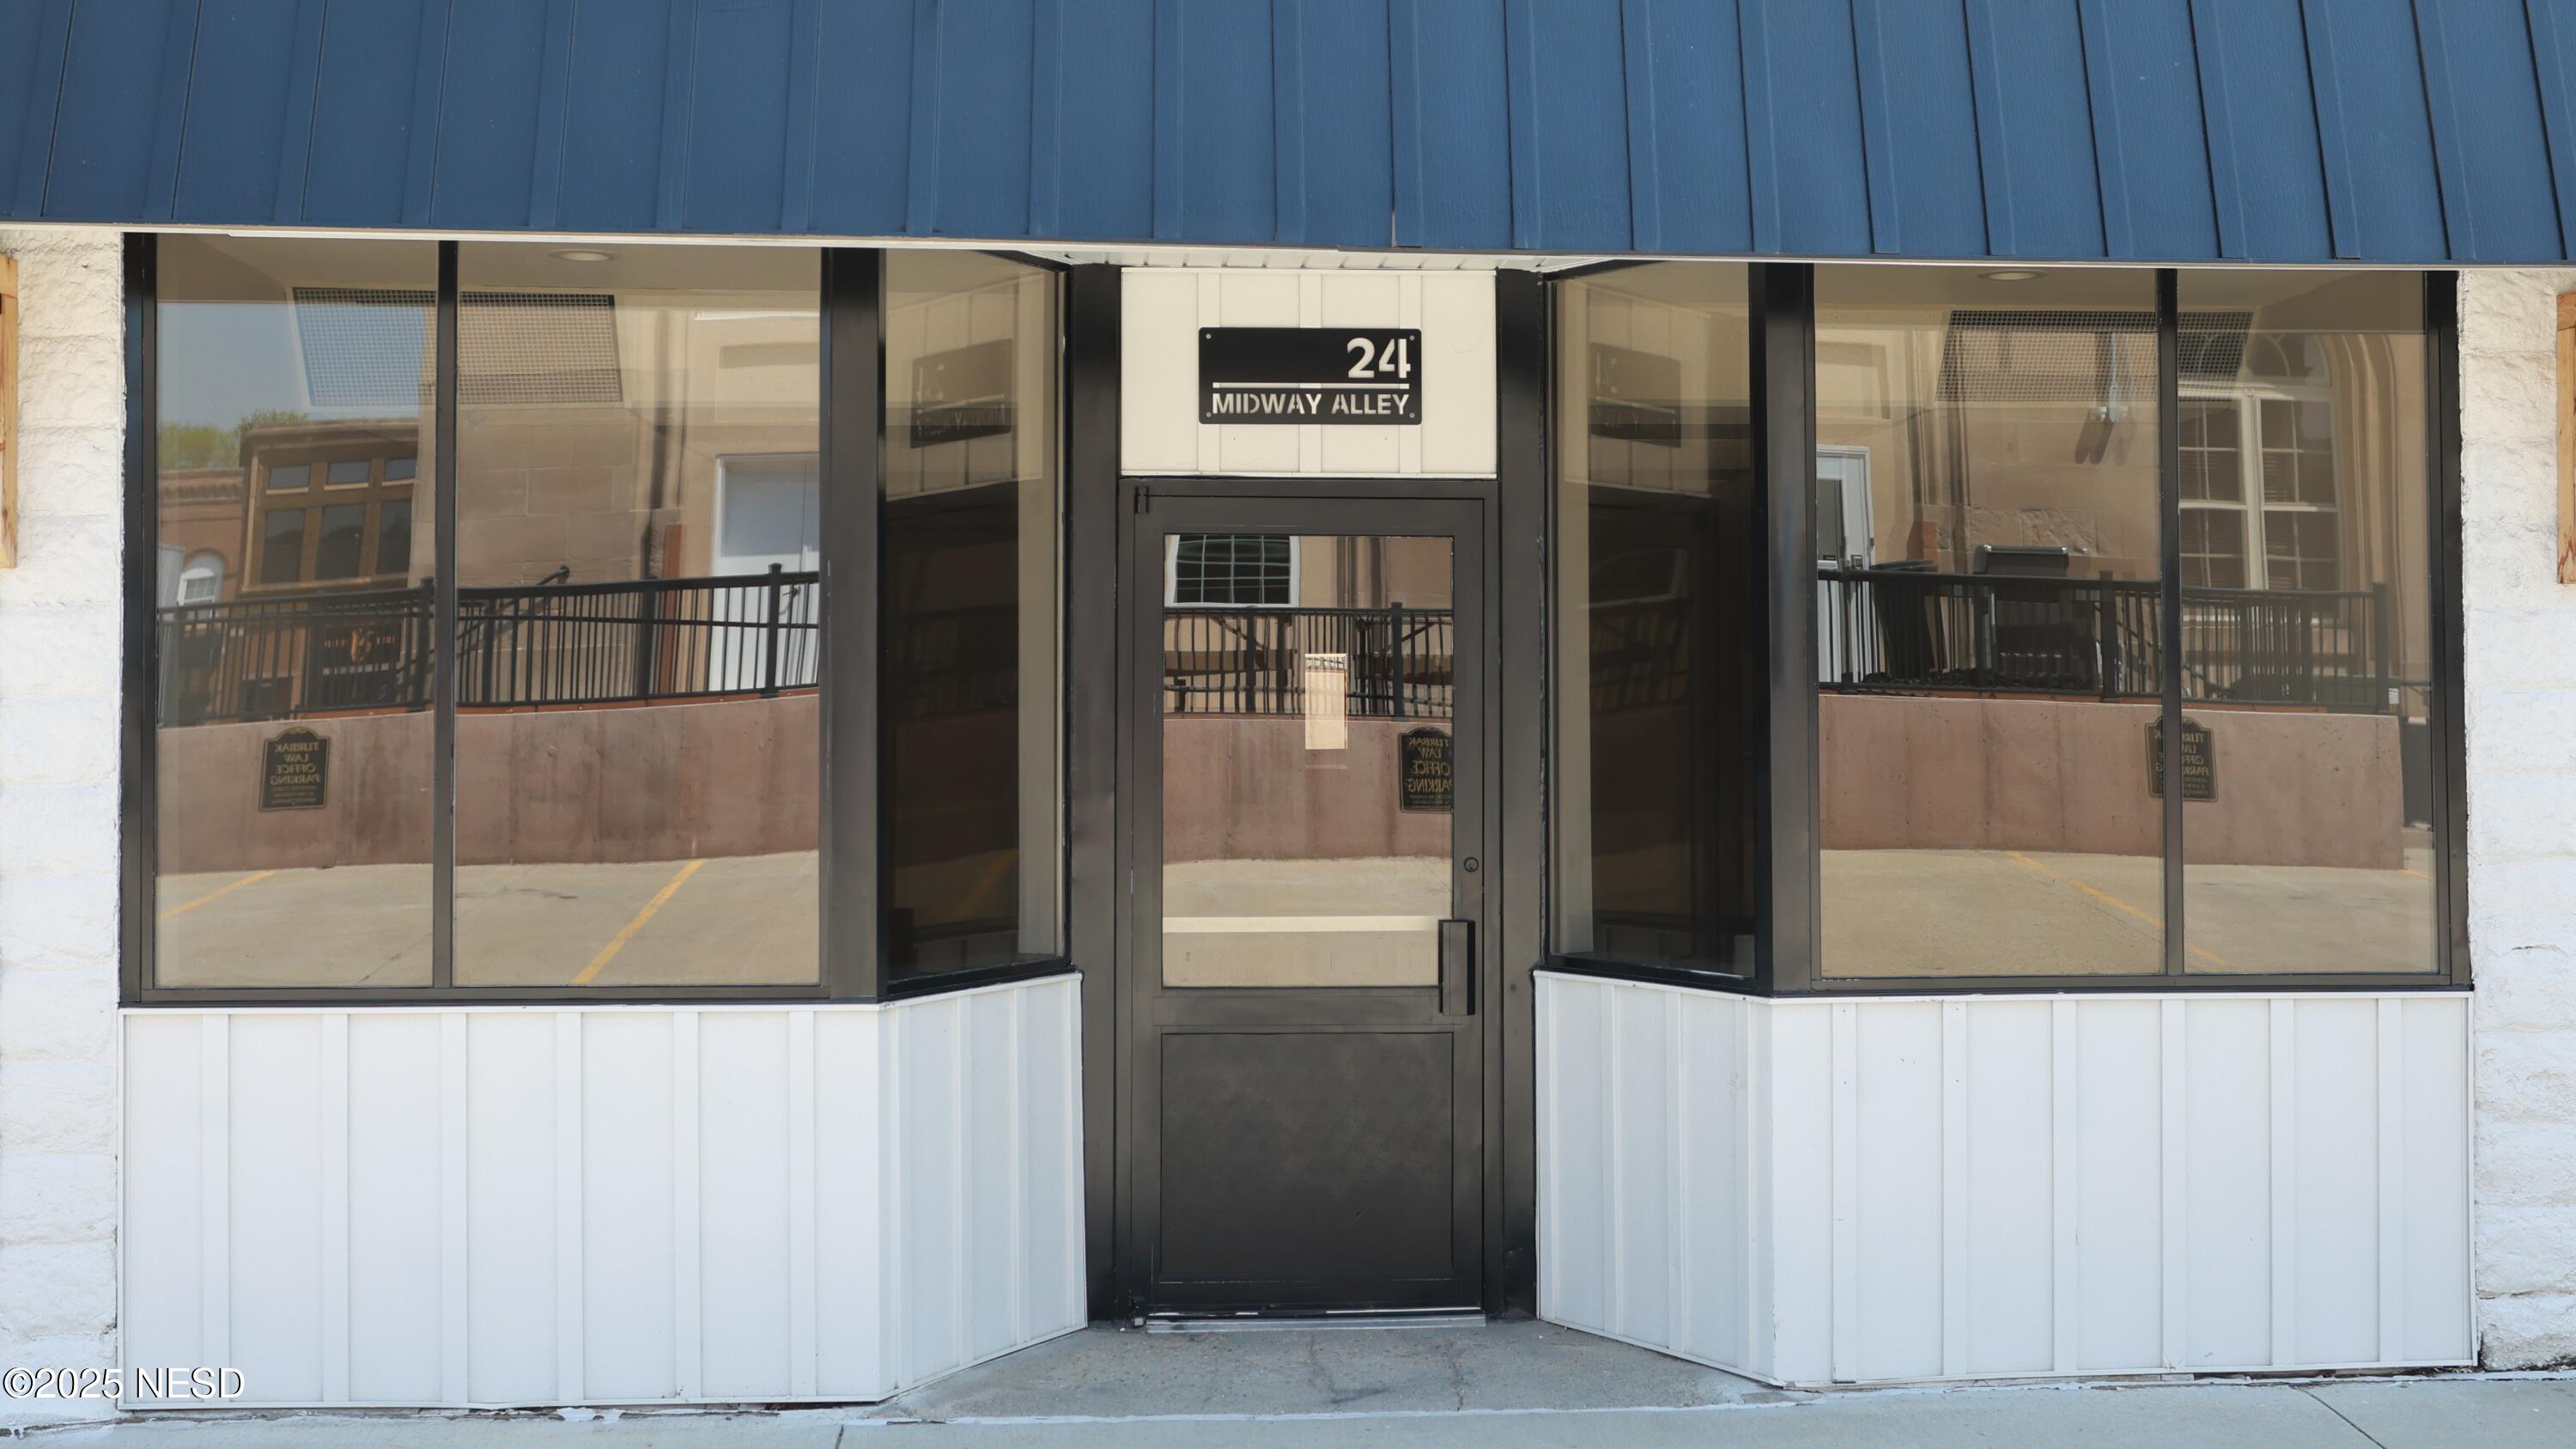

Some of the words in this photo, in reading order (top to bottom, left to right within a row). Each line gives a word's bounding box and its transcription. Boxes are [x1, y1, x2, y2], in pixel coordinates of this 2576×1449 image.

[1347, 337, 1411, 379] 24
[1212, 393, 1322, 415] MIDWAY
[1331, 393, 1409, 415] ALLEY
